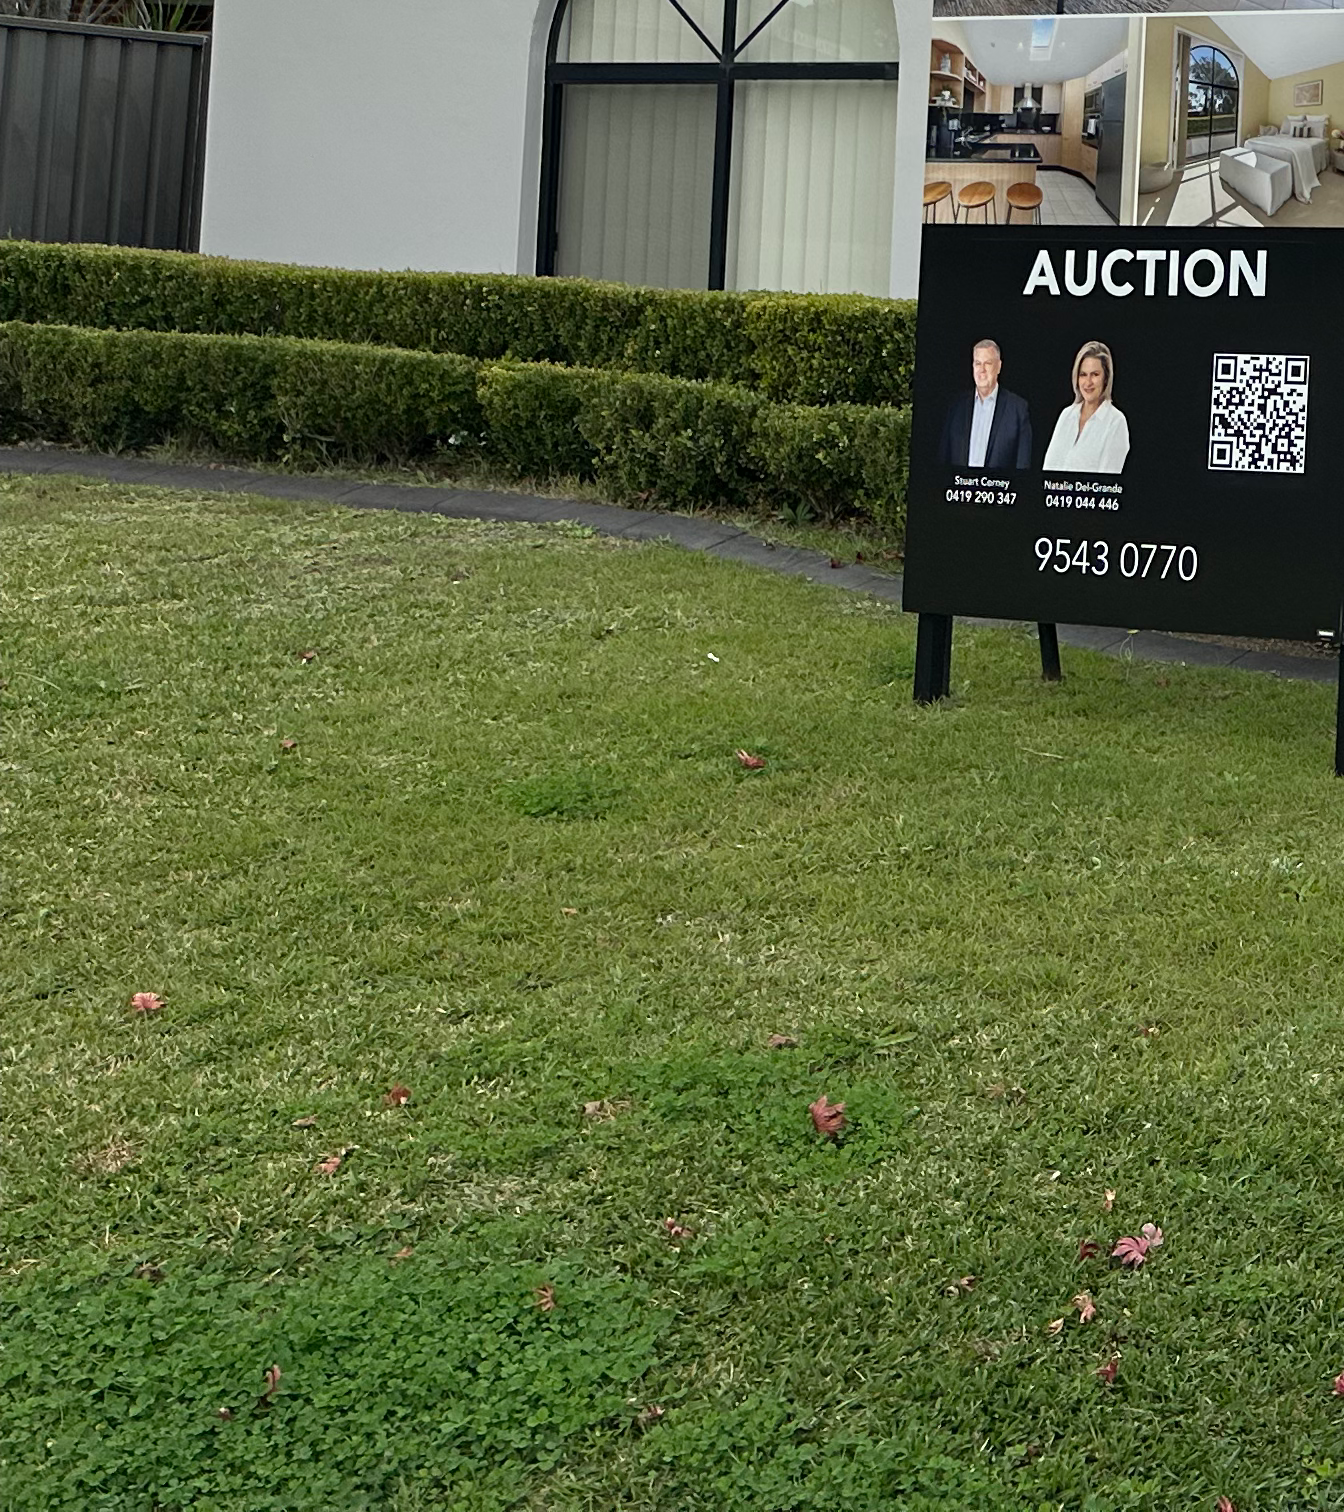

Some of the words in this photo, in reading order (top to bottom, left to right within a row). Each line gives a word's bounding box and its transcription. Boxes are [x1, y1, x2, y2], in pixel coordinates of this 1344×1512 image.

[1022, 248, 1268, 298] AUCTION
[954, 475, 979, 487] Stuart
[1043, 479, 1073, 492] Natalie
[946, 489, 973, 502] 0419
[974, 490, 995, 504] 290
[997, 492, 1017, 505] 347
[1045, 494, 1073, 508] 0419
[1075, 496, 1096, 509] 044
[1098, 497, 1119, 510] 446
[1034, 537, 1109, 576] 9543
[1120, 542, 1198, 581] 0770
